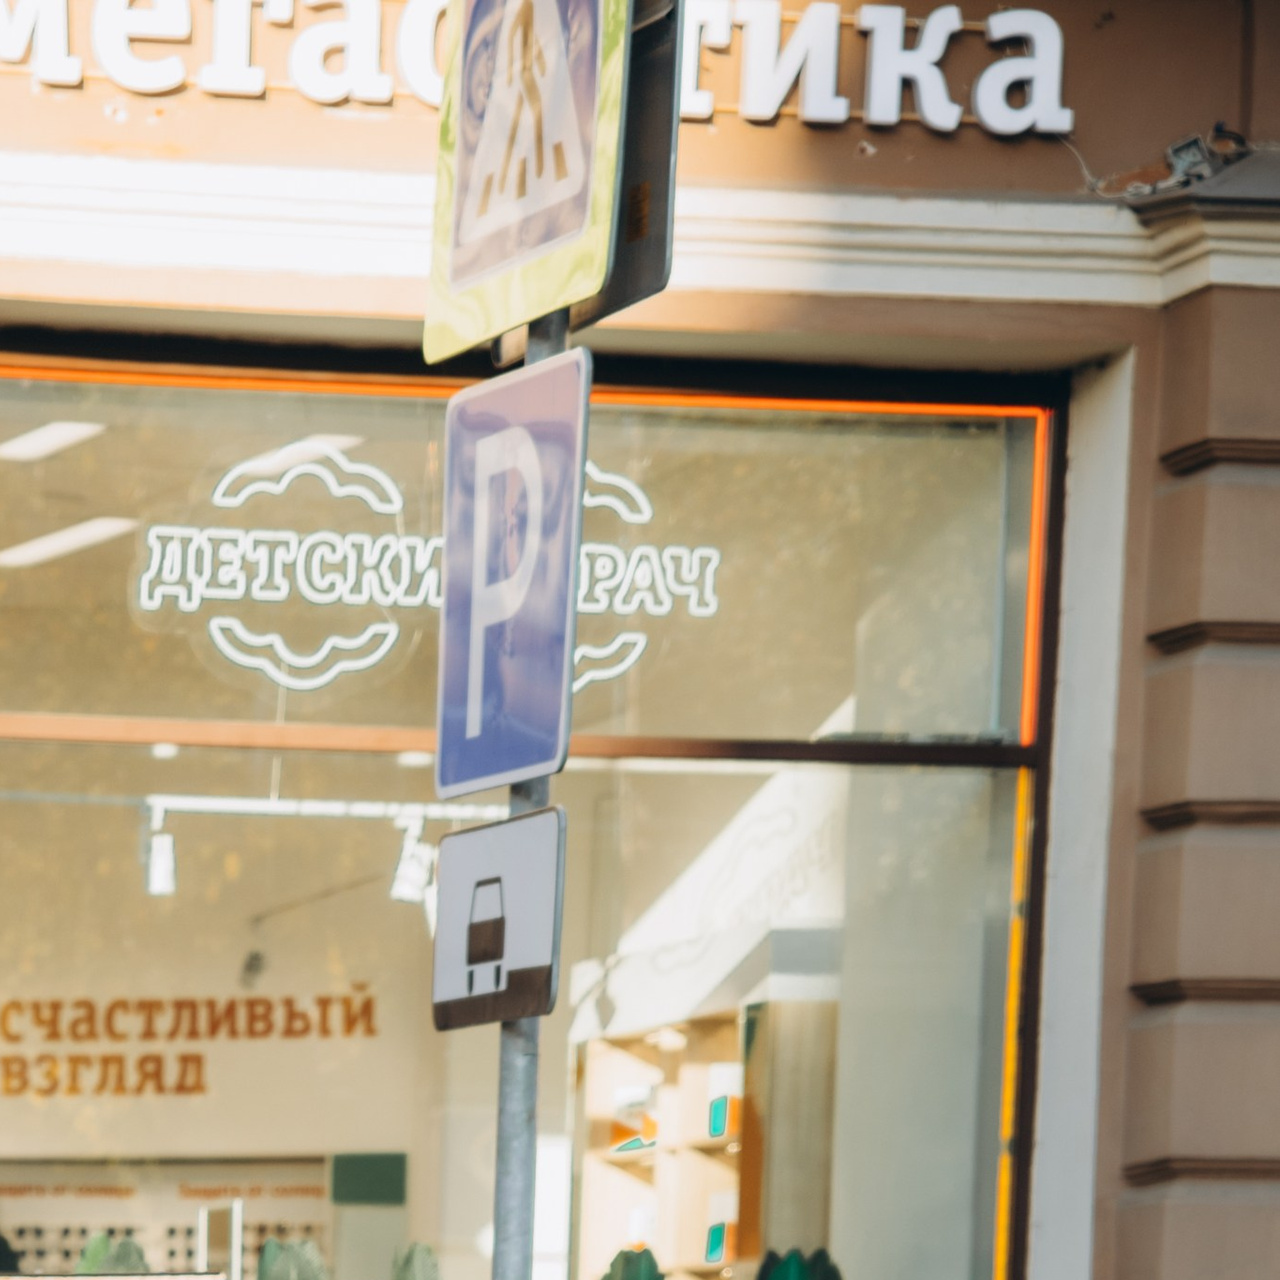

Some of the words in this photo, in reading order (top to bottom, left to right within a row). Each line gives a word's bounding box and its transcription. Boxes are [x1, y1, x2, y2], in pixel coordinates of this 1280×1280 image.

[140, 525, 444, 612] ДЕТСКИ
[577, 542, 721, 617] РАЧ
[466, 426, 542, 740] P
